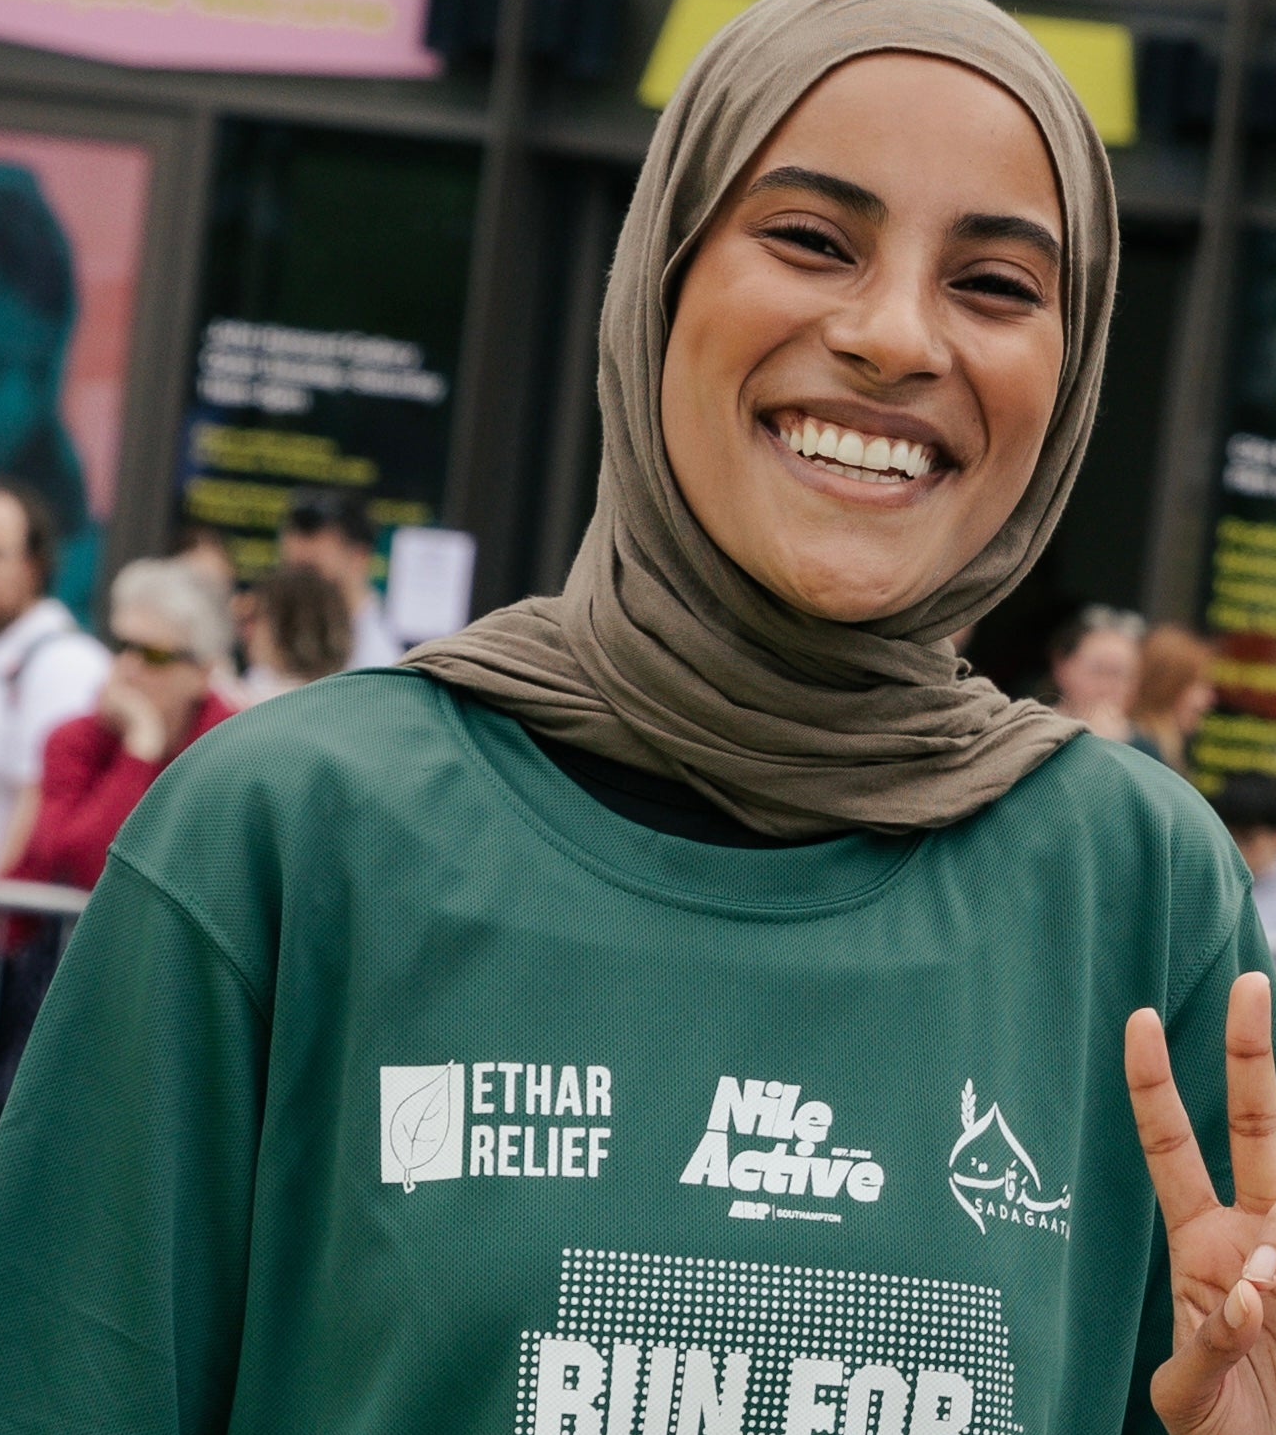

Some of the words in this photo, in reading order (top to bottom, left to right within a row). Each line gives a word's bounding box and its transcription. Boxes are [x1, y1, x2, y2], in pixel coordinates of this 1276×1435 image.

[472, 1062, 612, 1116] ETHAR
[706, 1075, 833, 1143] Nile
[470, 1125, 612, 1178] RELIEF
[678, 1130, 885, 1202] Active
[777, 1208, 841, 1223] SOUTHAMPTON
